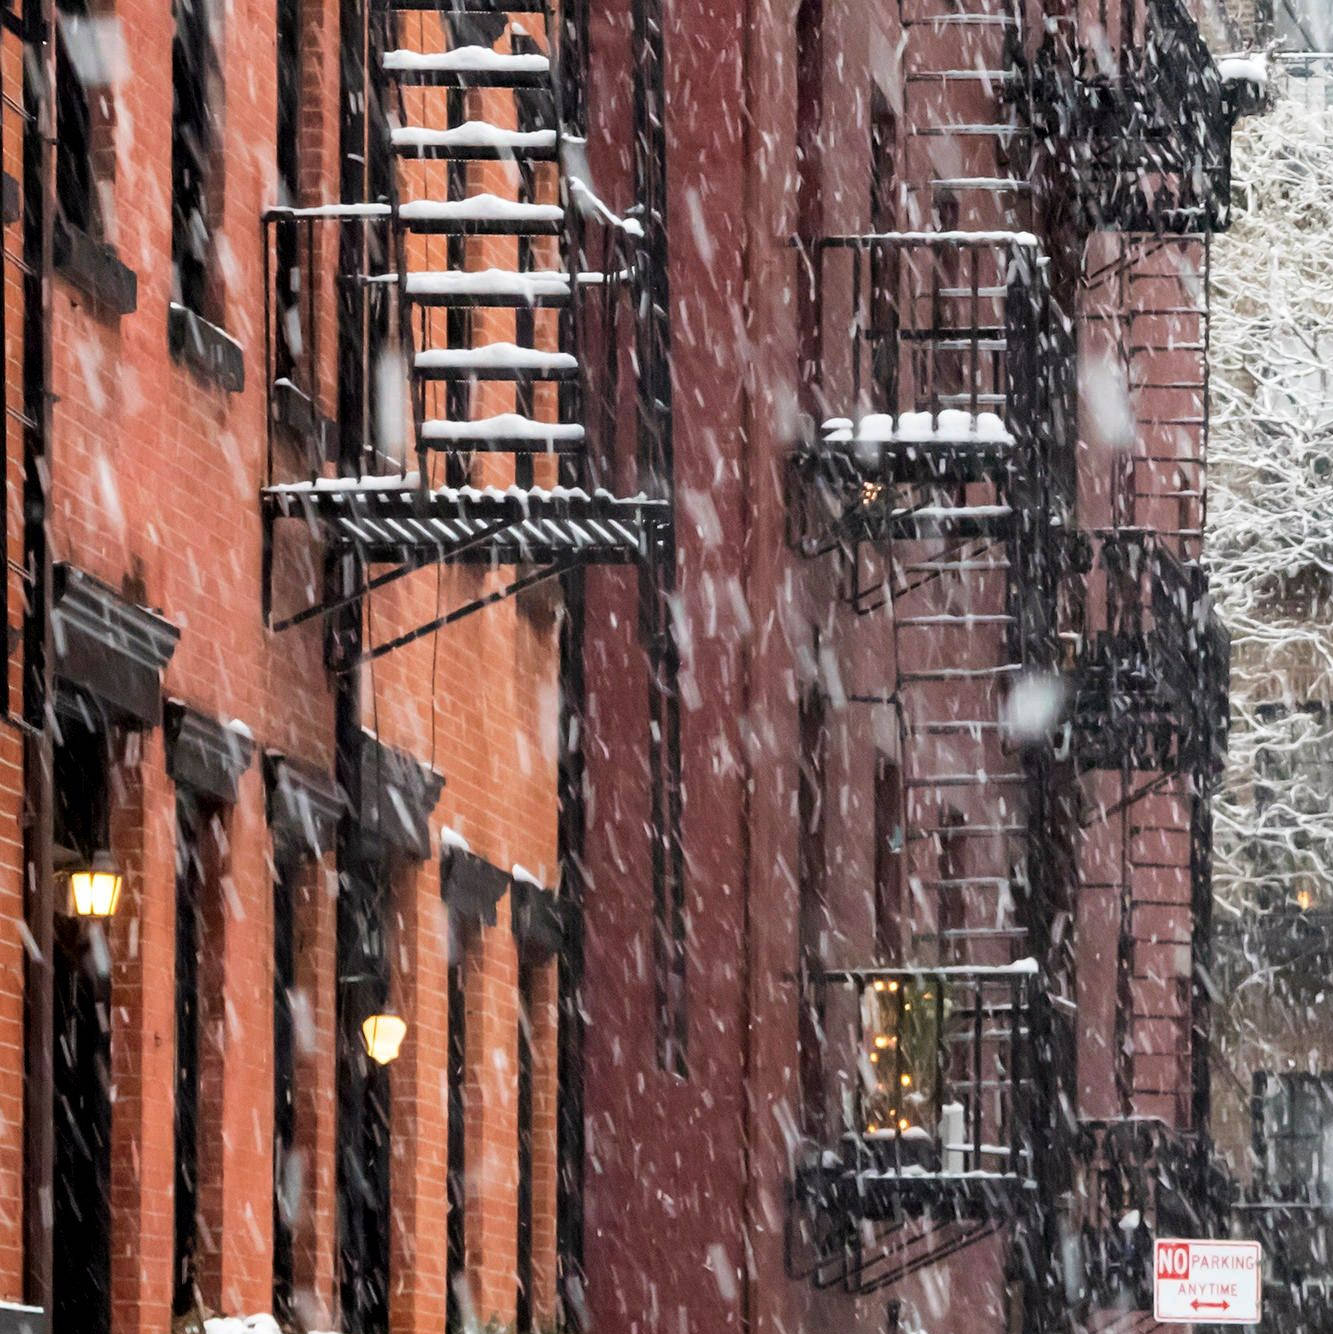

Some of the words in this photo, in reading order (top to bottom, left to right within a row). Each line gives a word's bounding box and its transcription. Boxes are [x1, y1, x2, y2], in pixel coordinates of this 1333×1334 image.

[1158, 1247, 1189, 1275] NO
[1191, 1254, 1255, 1270] PARKING
[1177, 1282, 1239, 1297] ANYTIME
